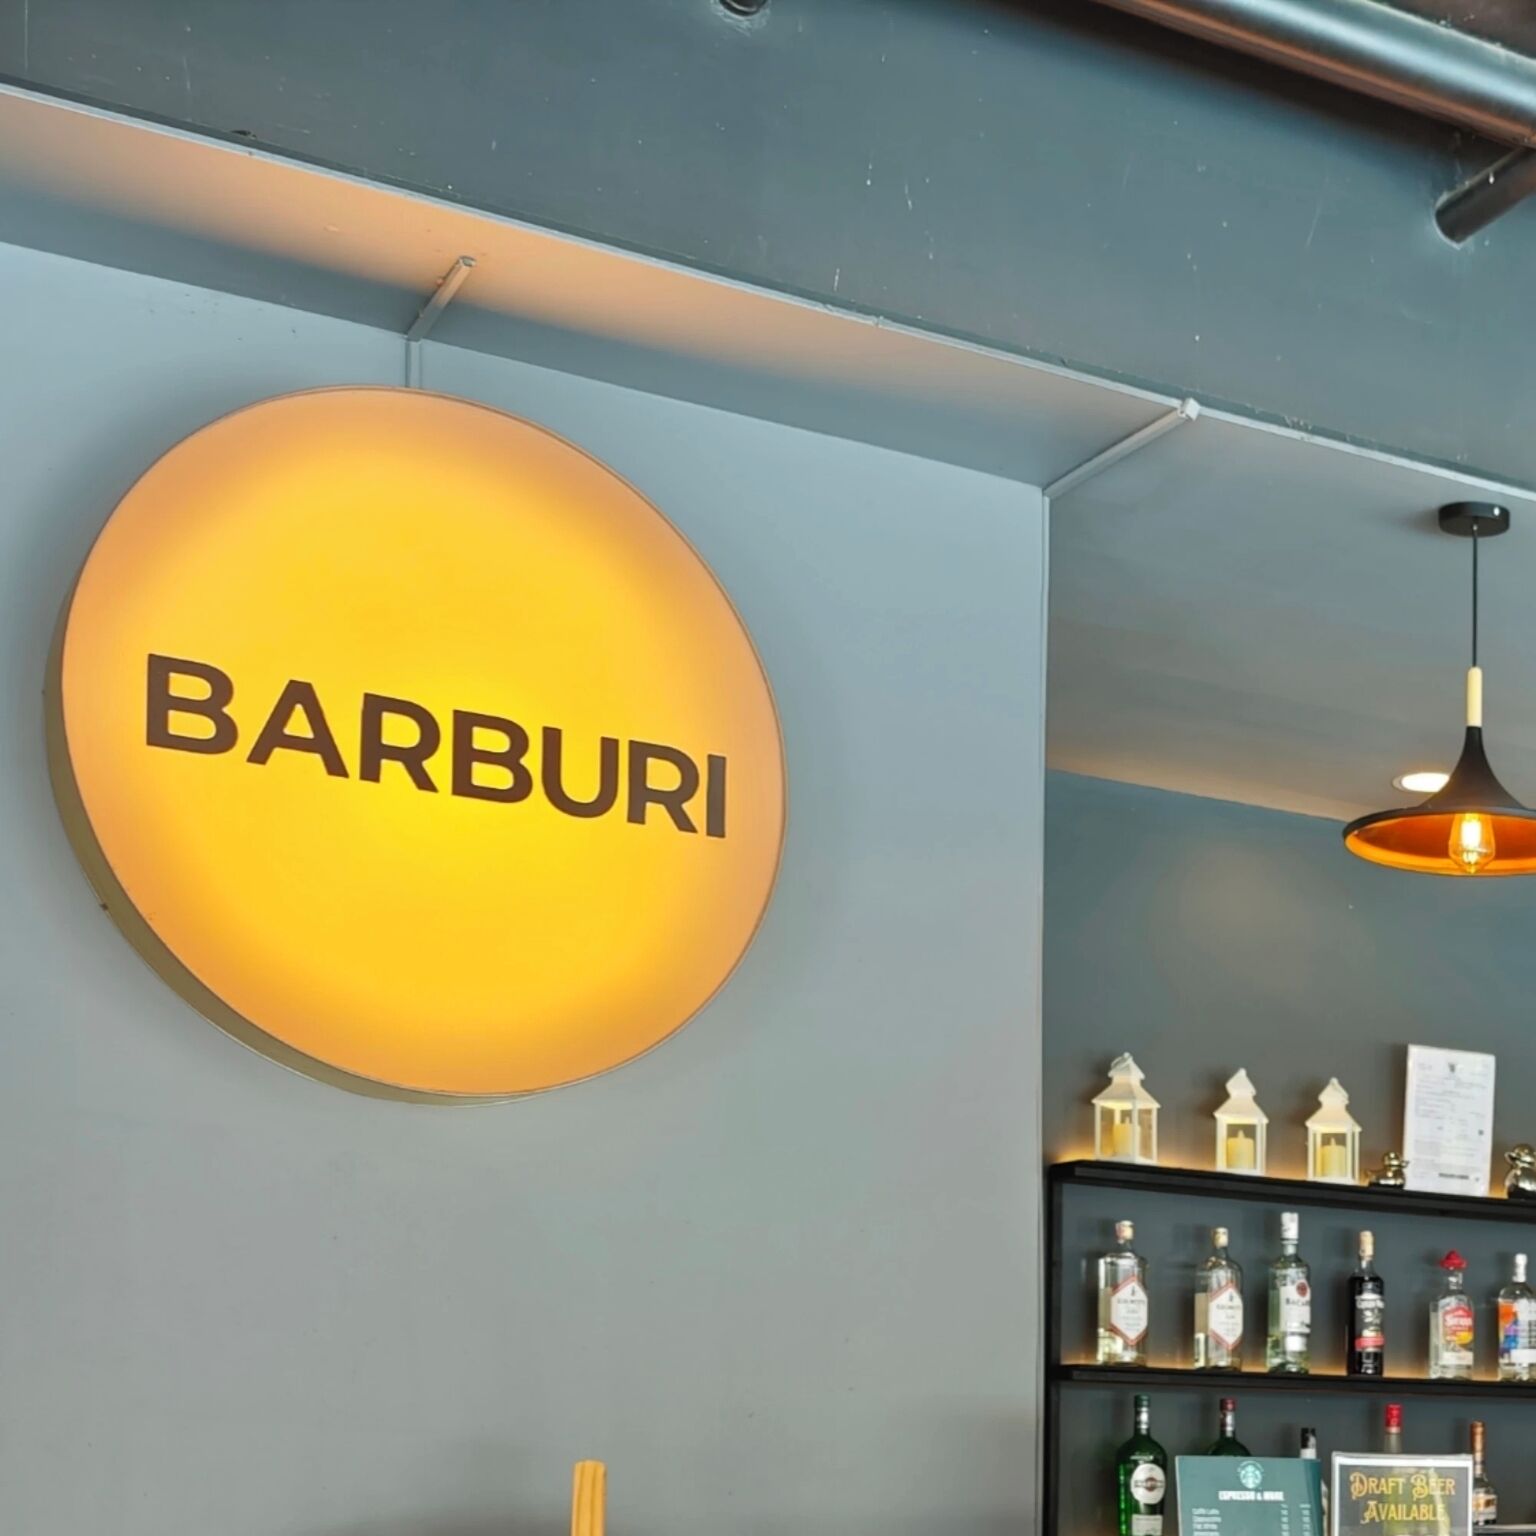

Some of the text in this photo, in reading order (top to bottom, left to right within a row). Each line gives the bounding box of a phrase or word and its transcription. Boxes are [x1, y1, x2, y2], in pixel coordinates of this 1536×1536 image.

[147, 653, 728, 839] BARBURI
[1350, 1471, 1456, 1501] DRAFT BEER
[1360, 1500, 1446, 1524] AVAILABLE
